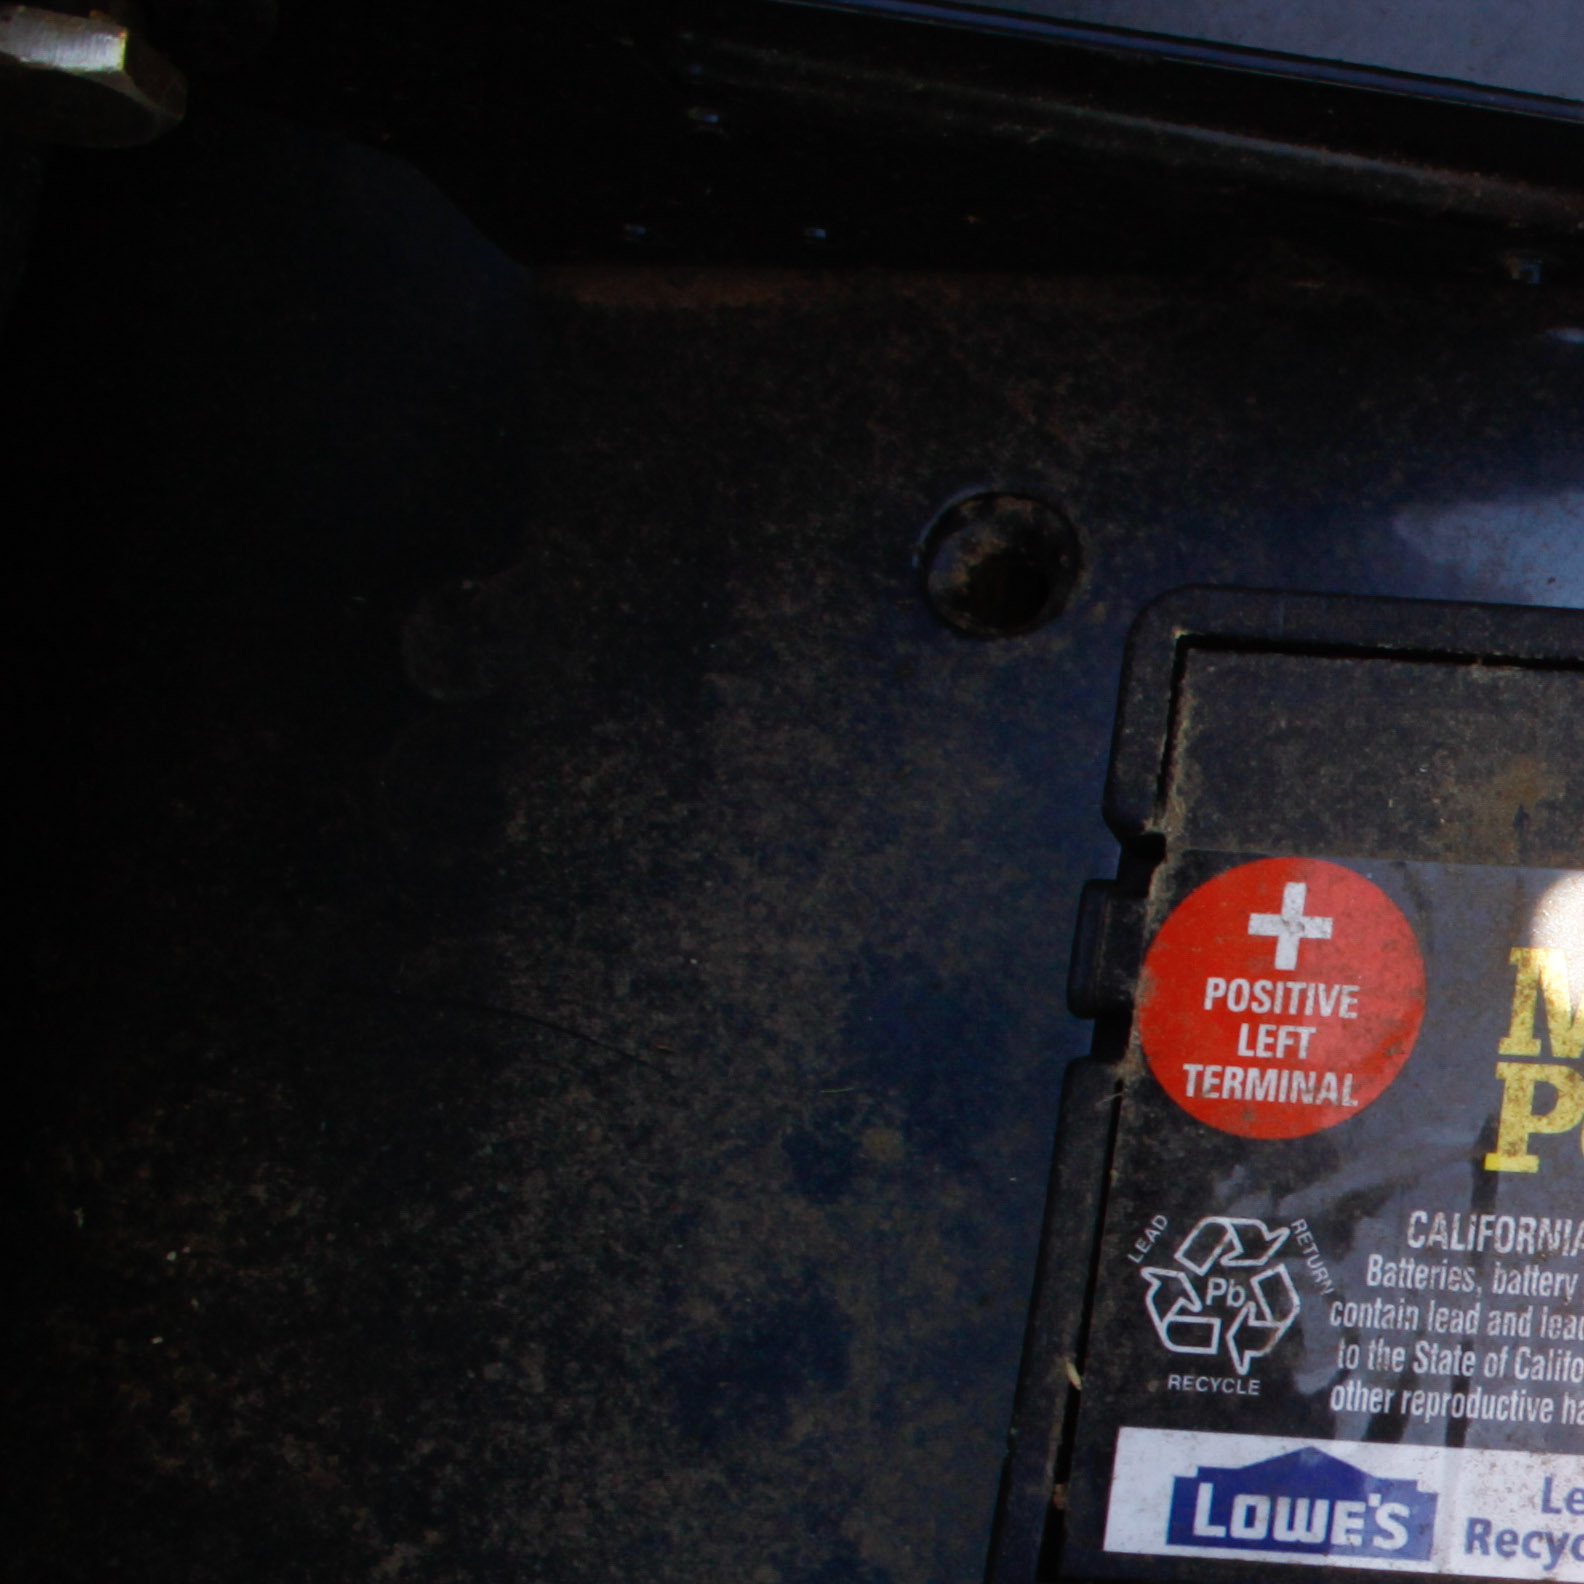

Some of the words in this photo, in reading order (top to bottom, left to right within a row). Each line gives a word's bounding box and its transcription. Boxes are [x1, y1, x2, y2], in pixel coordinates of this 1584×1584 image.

[1204, 977, 1360, 1018] POSITIVE
[1237, 1023, 1316, 1060] LEFT
[1183, 1064, 1358, 1106] TERMINAL
[1127, 1214, 1168, 1263] LEAD
[1290, 1218, 1336, 1296] RETURN
[1205, 1277, 1246, 1308] Pb
[1366, 1254, 1482, 1298] Batteries,
[1492, 1260, 1579, 1305] battery
[1330, 1300, 1418, 1332] contain
[1427, 1301, 1480, 1335] lead
[1487, 1305, 1531, 1338] and
[1336, 1337, 1360, 1370] to
[1368, 1338, 1405, 1372] the
[1413, 1340, 1475, 1376] State
[1484, 1344, 1510, 1379] of
[1167, 1374, 1261, 1396] RECYCLE
[1330, 1382, 1395, 1413] other
[1401, 1386, 1553, 1424] reproductive
[1193, 1483, 1410, 1550] LOWE'S
